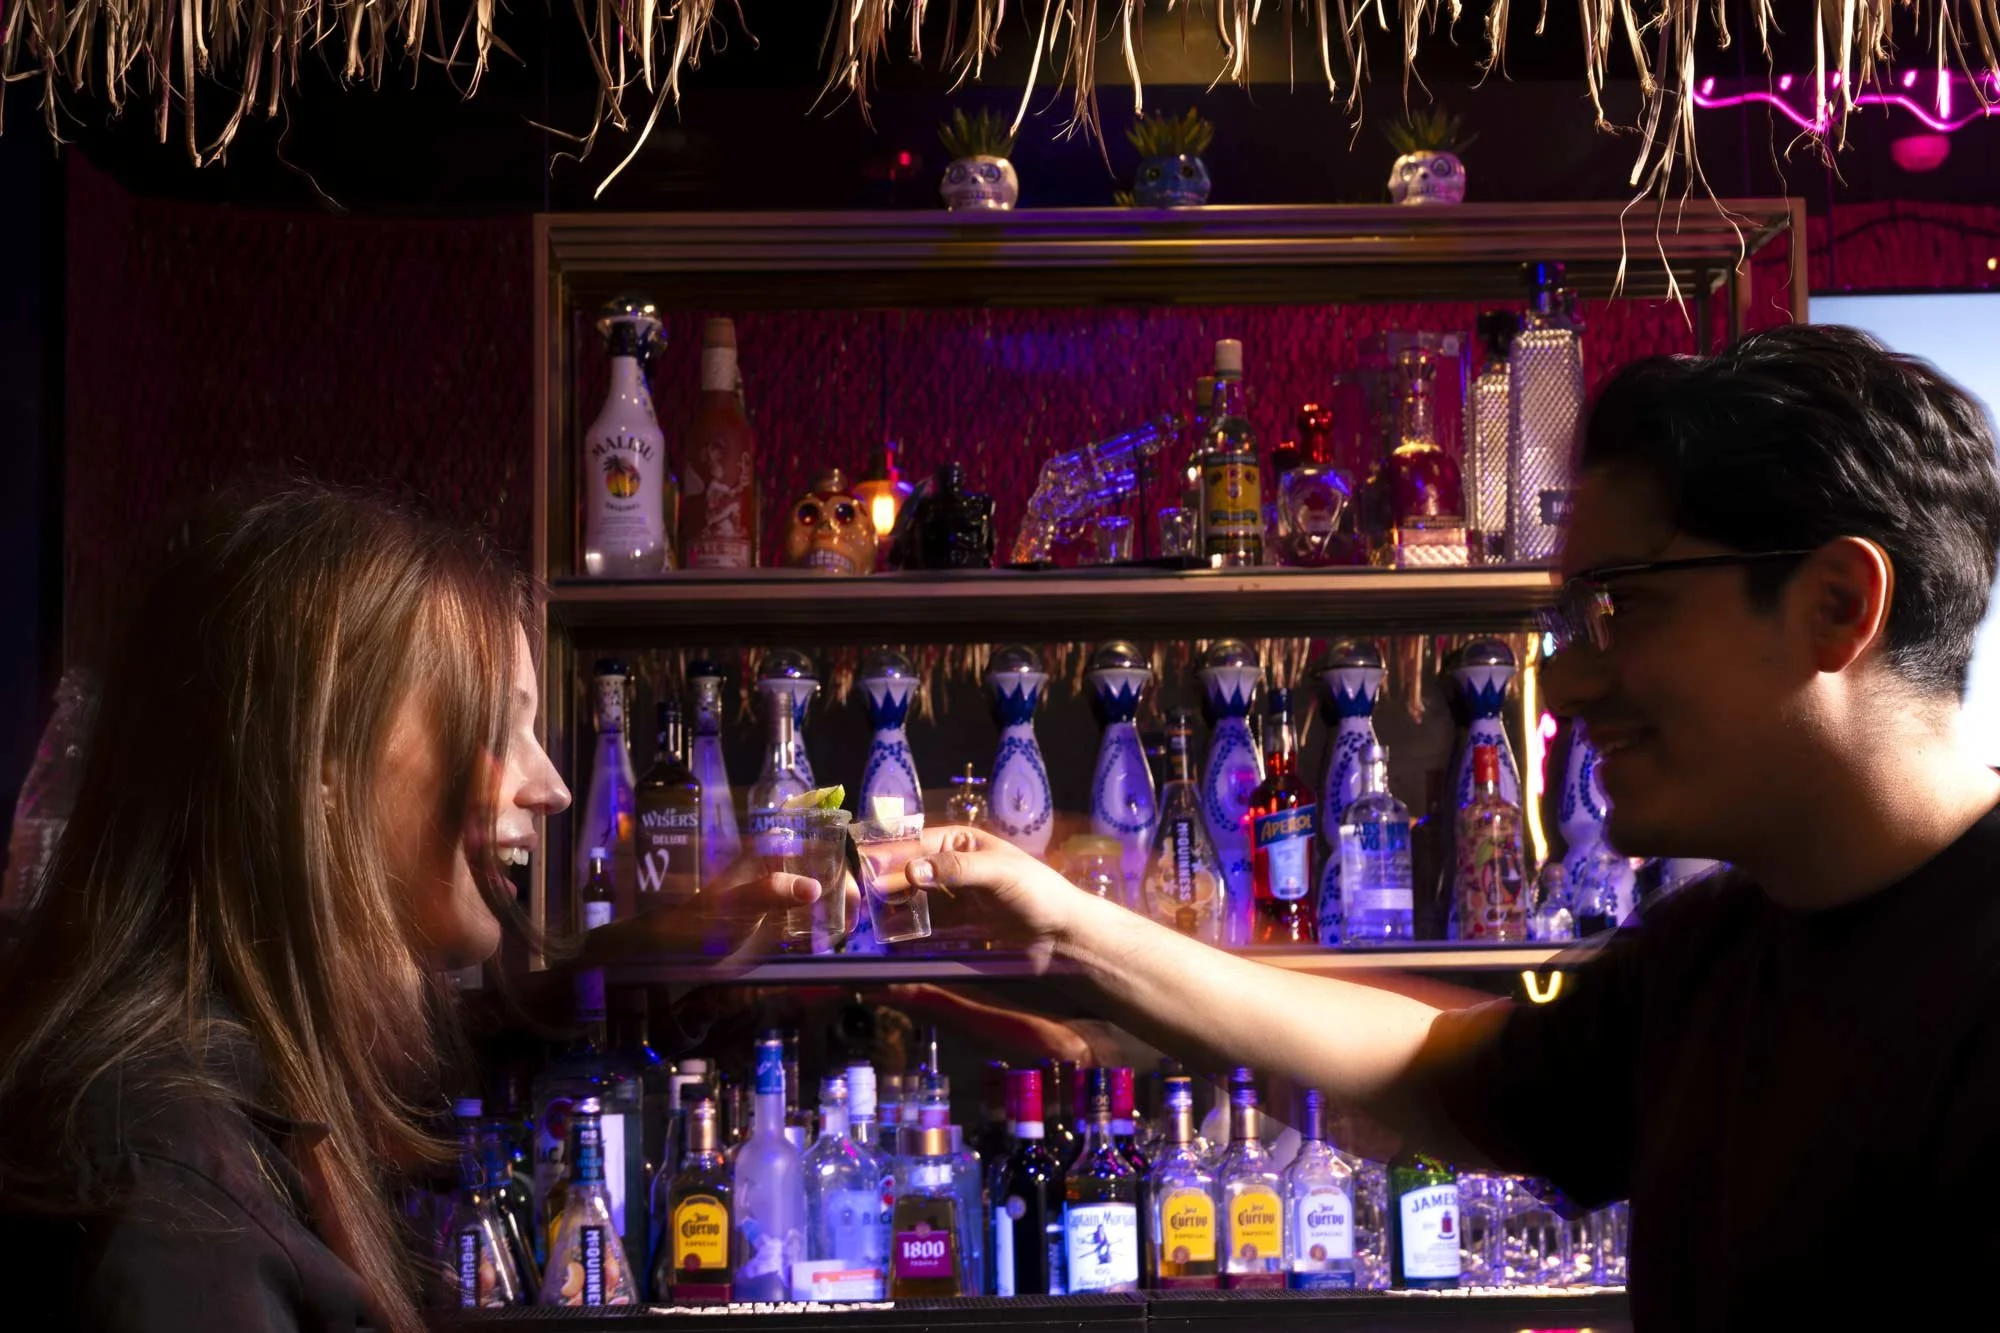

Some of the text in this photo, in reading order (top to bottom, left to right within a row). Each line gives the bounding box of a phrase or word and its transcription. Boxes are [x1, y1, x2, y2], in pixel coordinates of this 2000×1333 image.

[592, 435, 655, 461] MALIBU
[1260, 813, 1313, 842] APEROL
[652, 834, 688, 845] DELUXE
[1170, 1211, 1208, 1230] Cuervo
[1237, 1208, 1275, 1226] Cuervo
[1306, 1209, 1345, 1228] Cuervo
[681, 1219, 720, 1239] Cuervo
[902, 1240, 945, 1259] 1800
